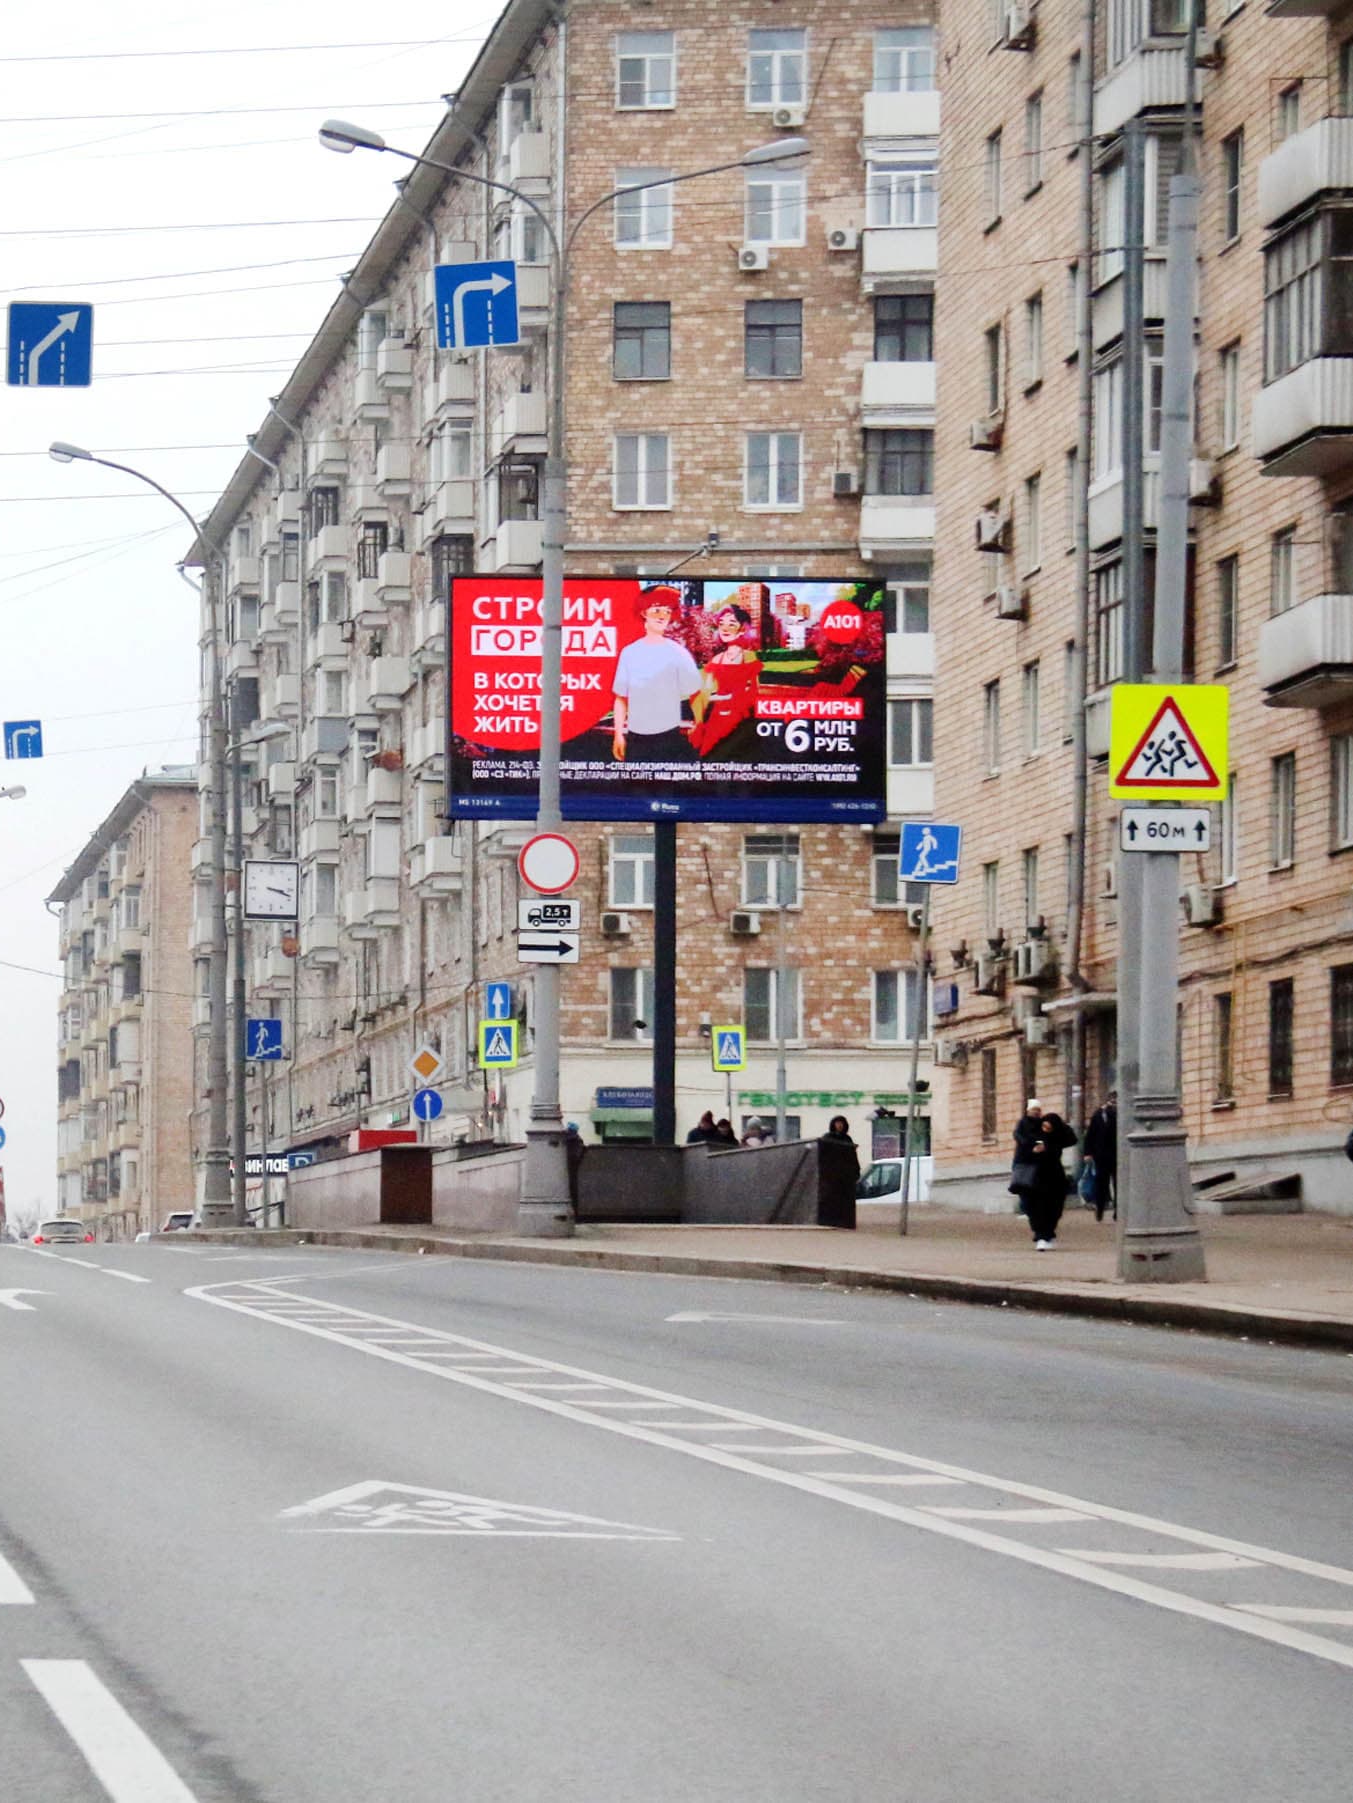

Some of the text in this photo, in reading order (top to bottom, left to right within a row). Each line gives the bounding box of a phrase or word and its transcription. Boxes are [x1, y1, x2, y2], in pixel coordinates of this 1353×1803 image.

[475, 629, 612, 655] ГОРДА
[473, 672, 489, 689] В
[473, 693, 575, 712] ХОЧЕТЯ
[756, 700, 861, 716] КВАРТИРЫ
[473, 716, 539, 733] ЖИТЬ
[756, 719, 857, 753] ОТ 6 МЛН
[814, 737, 856, 752] РУБ.
